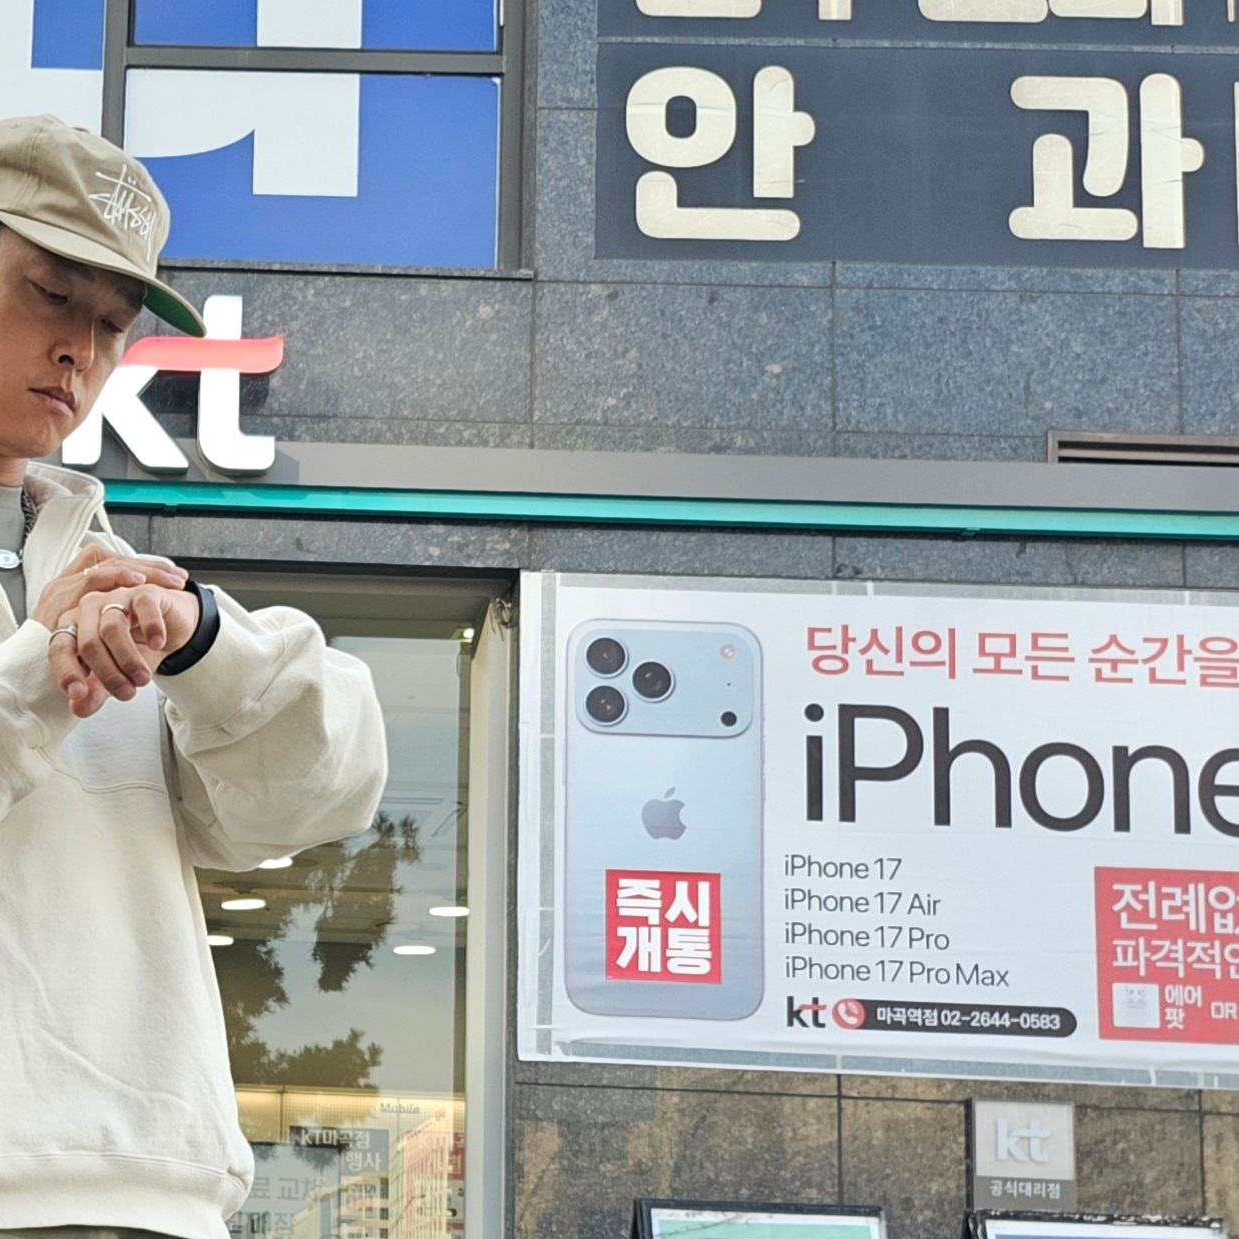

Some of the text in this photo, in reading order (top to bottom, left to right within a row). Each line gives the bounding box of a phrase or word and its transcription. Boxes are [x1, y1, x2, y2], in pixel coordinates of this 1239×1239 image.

[62, 294, 284, 471] kt
[806, 624, 1239, 689] 당신의 모든 순간을
[784, 854, 903, 880] iPhone 17
[616, 878, 711, 927] 즉시
[784, 888, 942, 916] iPhone 17 Air
[616, 926, 712, 975] 개통
[784, 922, 950, 950] iPhone 17 Pro
[784, 956, 1010, 987] iPhone 17 Pro Max
[1164, 984, 1203, 1007] 에어
[786, 996, 827, 1029] kt
[876, 1006, 1061, 1030] 마곡역점 02-2644-0583
[1211, 1001, 1238, 1020] OR
[996, 1117, 1051, 1163] kt
[989, 1180, 1061, 1200] 공식대리점
